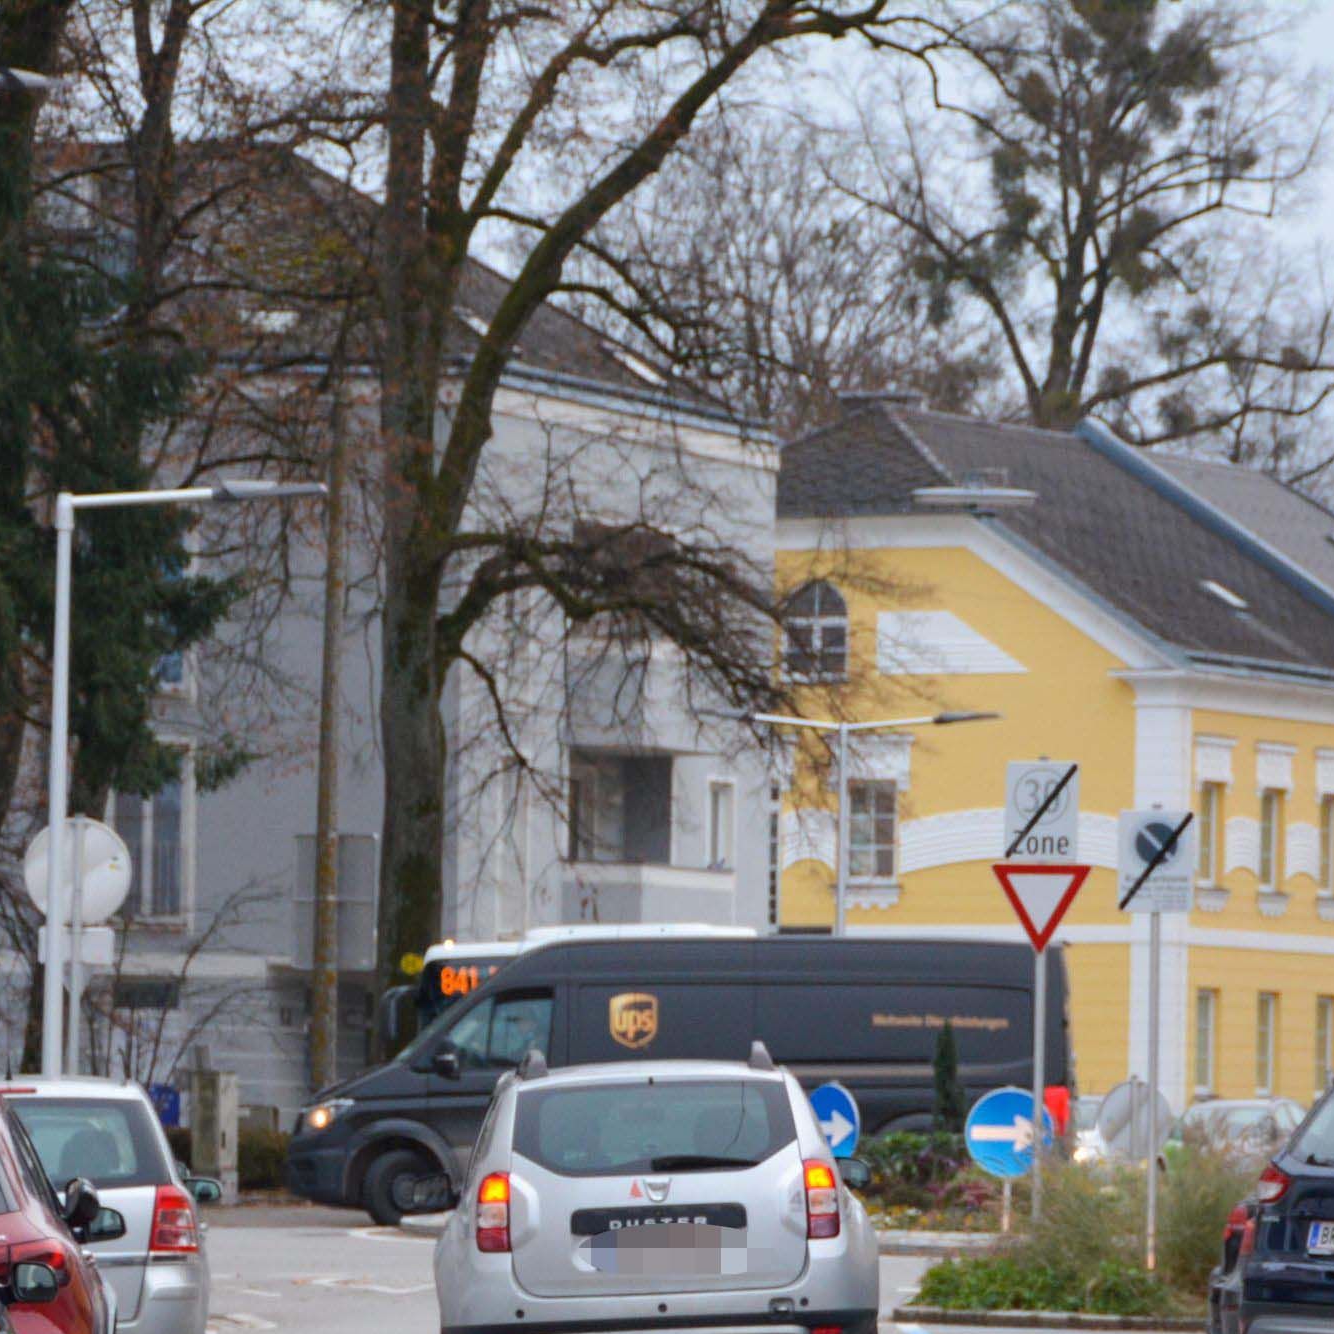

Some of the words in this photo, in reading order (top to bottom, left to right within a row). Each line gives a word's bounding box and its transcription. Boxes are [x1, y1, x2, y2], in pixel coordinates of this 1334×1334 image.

[1024, 779, 1060, 813] 30
[1012, 830, 1069, 856] Zone
[440, 966, 478, 996] 841
[614, 1007, 655, 1041] ups
